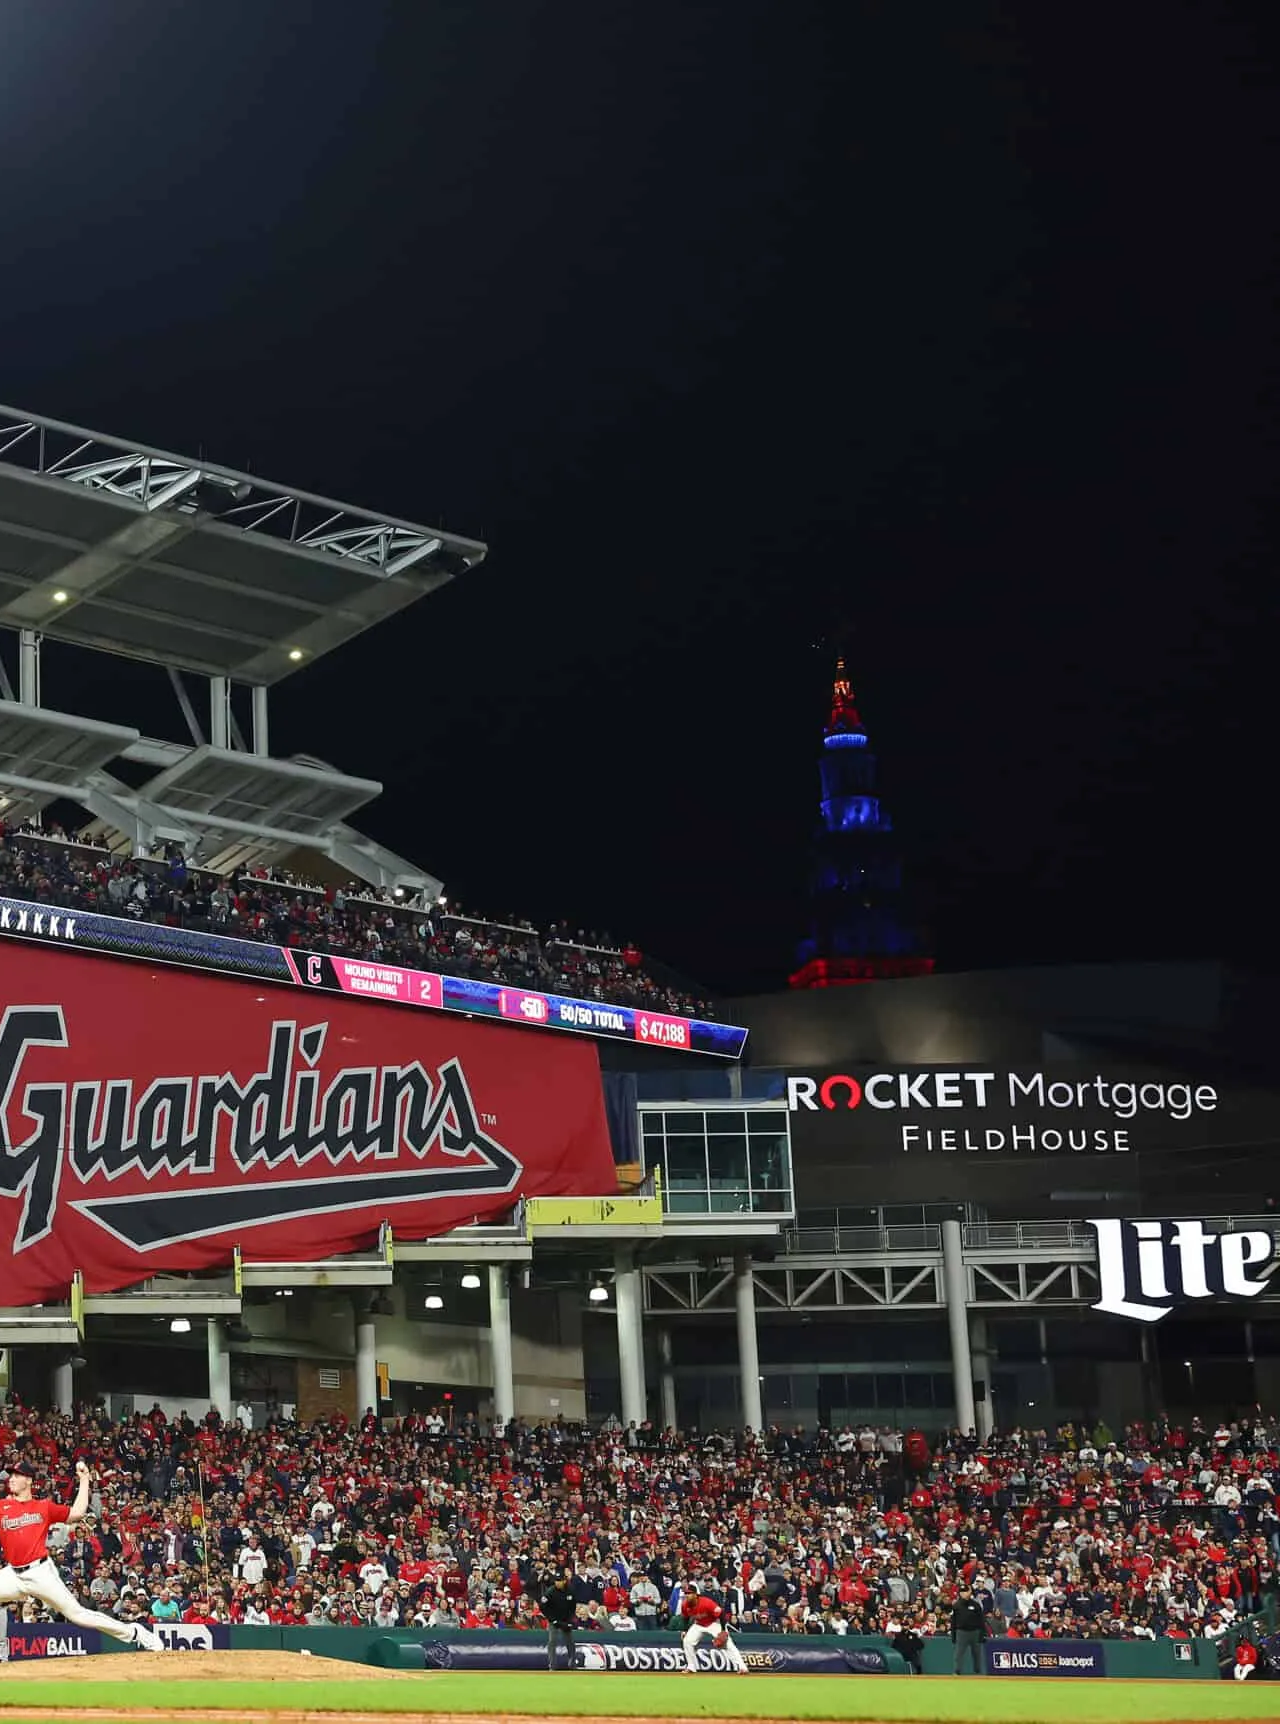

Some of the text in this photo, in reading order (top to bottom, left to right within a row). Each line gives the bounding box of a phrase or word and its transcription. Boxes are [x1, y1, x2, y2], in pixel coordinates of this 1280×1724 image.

[344, 963, 403, 984] MOUND VISITS
[351, 977, 397, 995] REMAINING
[420, 980, 431, 999] 2
[560, 1004, 626, 1030] 50/50 TOTAL
[787, 1072, 1218, 1120] ROCKET Mortgage
[1085, 1217, 1273, 1322] Lite
[606, 1645, 772, 1670] POSTSESON 2024
[1012, 1653, 1038, 1668] ALCS
[1039, 1657, 1057, 1665] 2024
